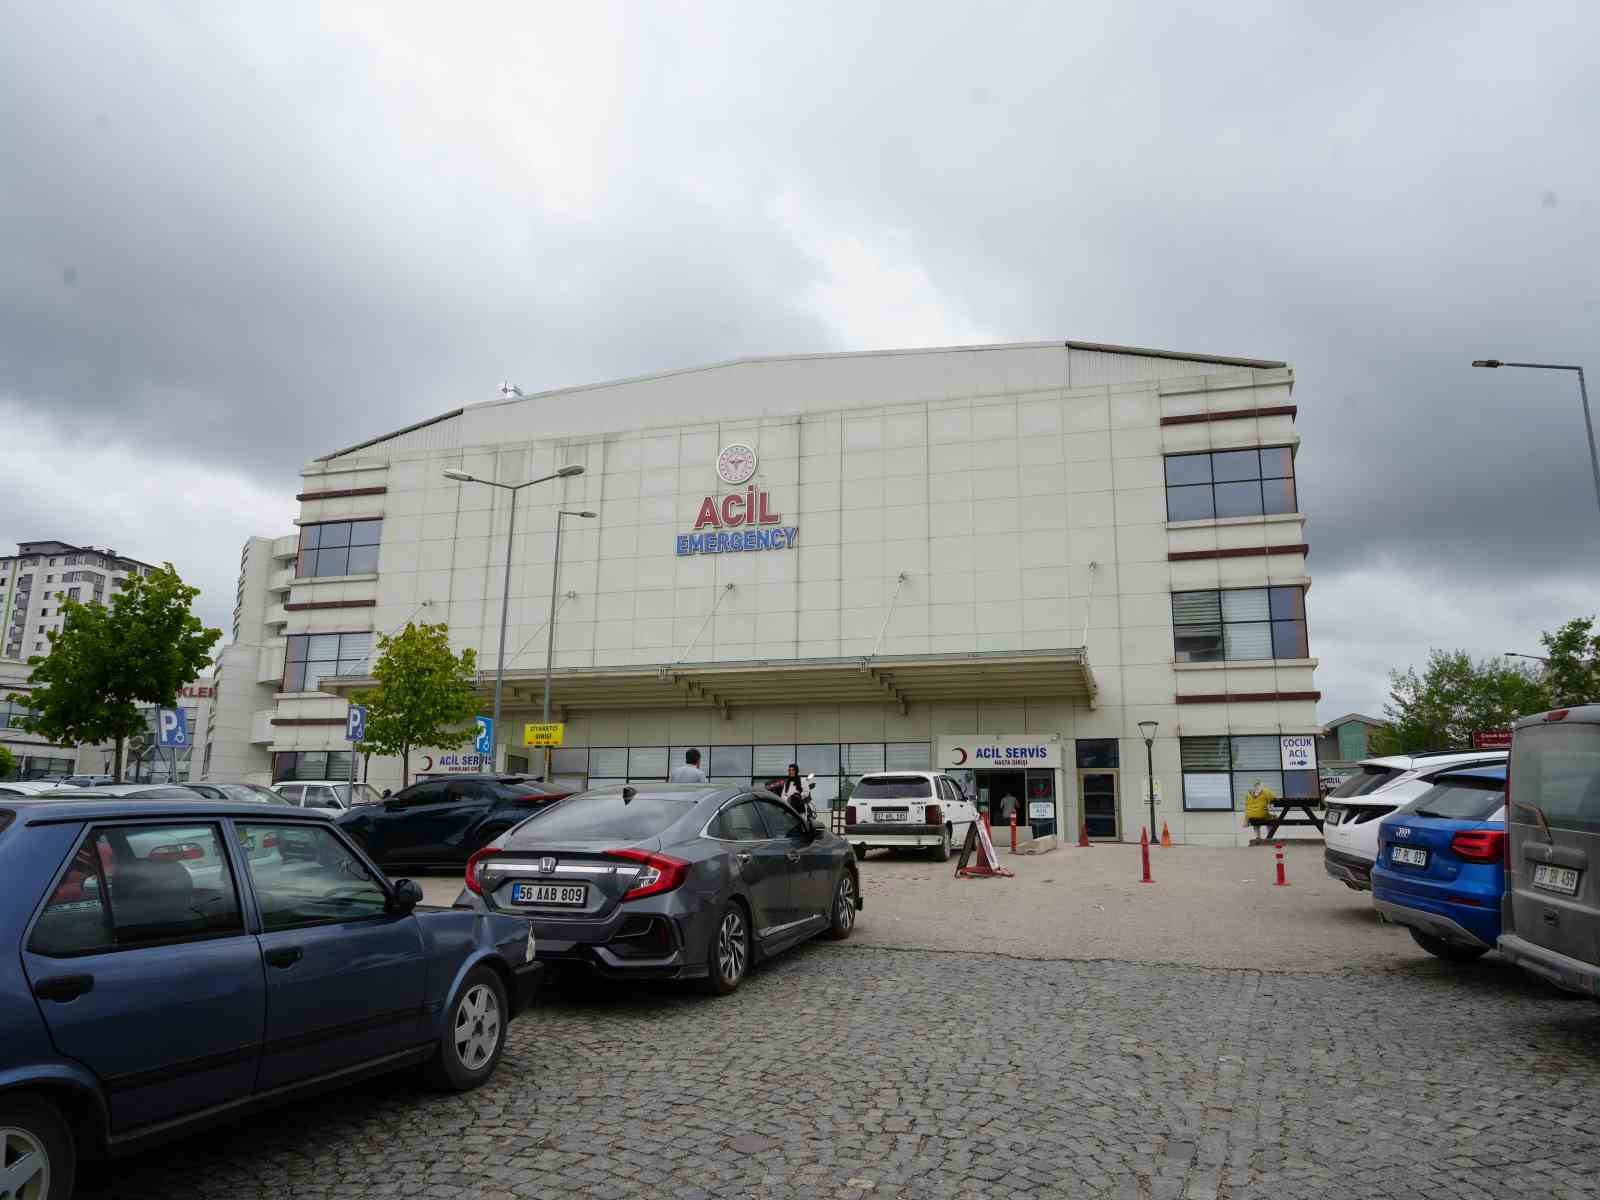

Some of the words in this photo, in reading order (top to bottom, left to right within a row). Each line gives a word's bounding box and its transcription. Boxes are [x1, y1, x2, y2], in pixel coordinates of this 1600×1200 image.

[694, 484, 781, 529] ACİL
[676, 527, 799, 556] EMERGENCY
[160, 710, 178, 742] P
[976, 744, 1002, 759] ACİL
[1006, 744, 1047, 759] SERVİS
[1283, 738, 1312, 750] ÇOCUK
[440, 752, 459, 766] ACİL
[1289, 747, 1308, 758] ACİL
[519, 886, 533, 900] 56
[536, 887, 558, 901] AAB
[561, 888, 583, 902] 809
